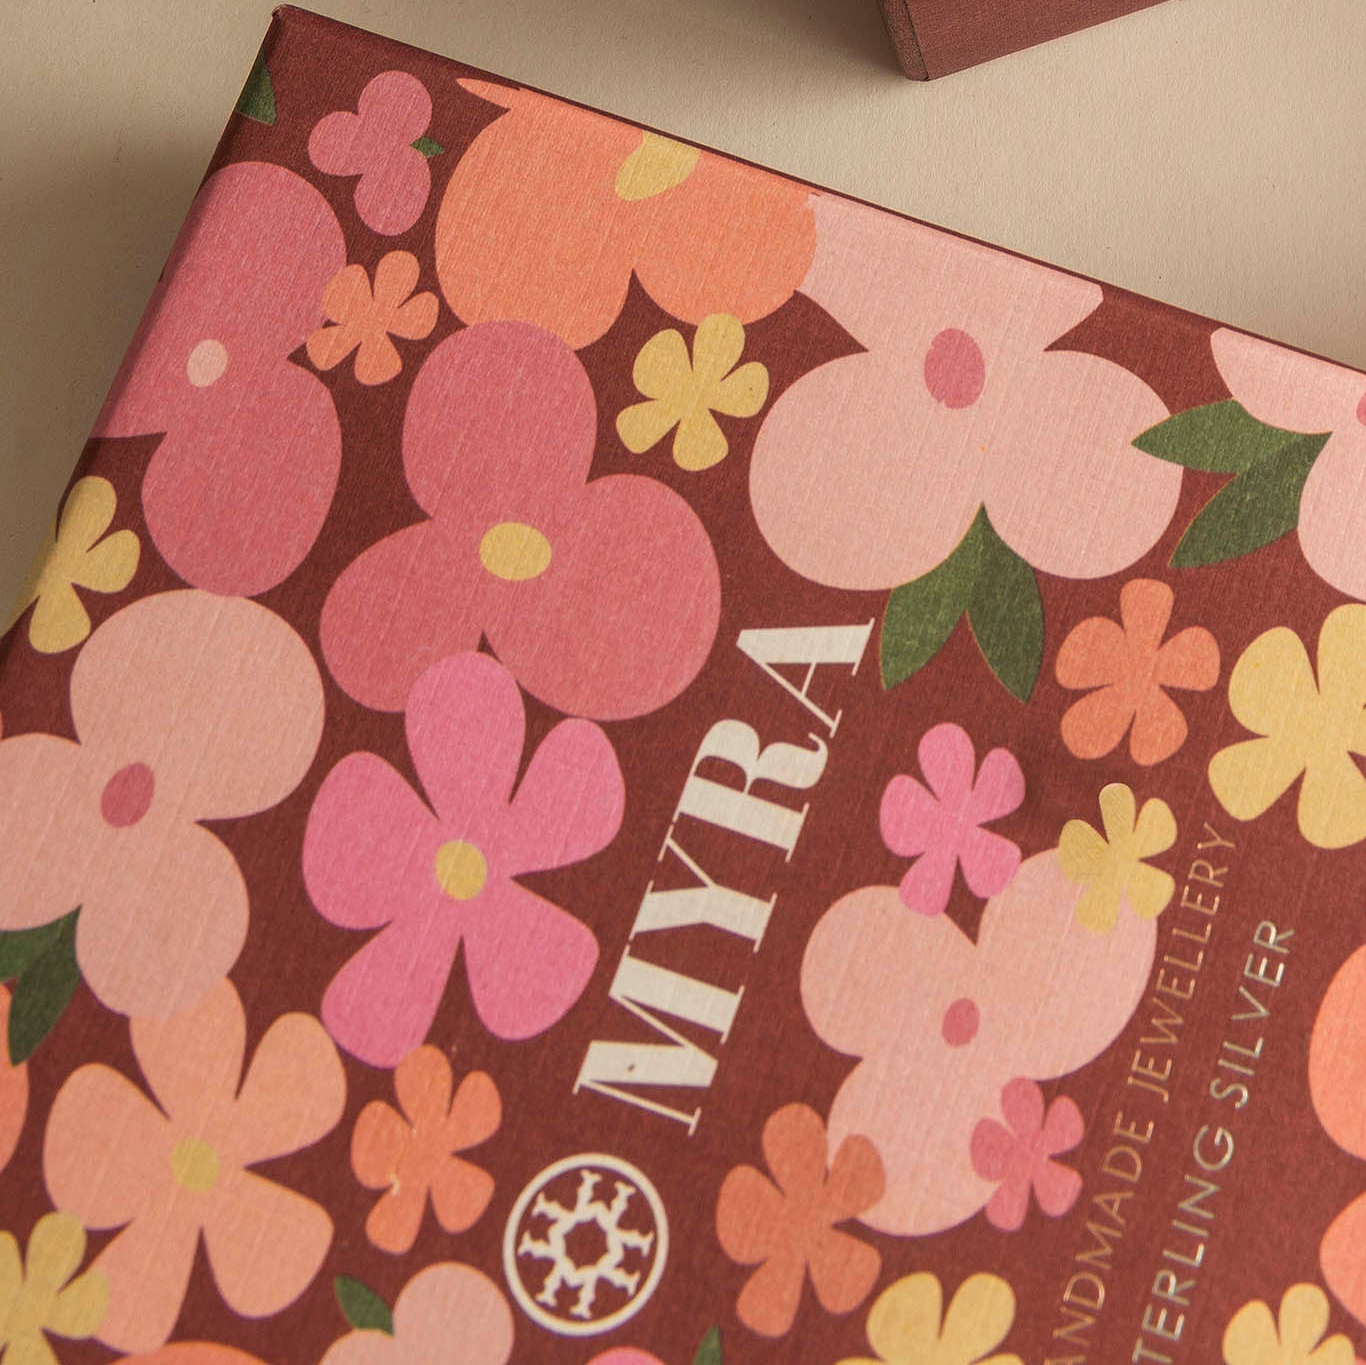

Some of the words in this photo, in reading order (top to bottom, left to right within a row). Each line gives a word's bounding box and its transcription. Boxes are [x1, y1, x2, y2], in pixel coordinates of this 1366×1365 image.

[571, 617, 875, 1136] MYRA
[1128, 821, 1236, 1103] JEWELLERY
[1132, 1124, 1235, 1364] TERLING
[1209, 919, 1295, 1109] SILVER
